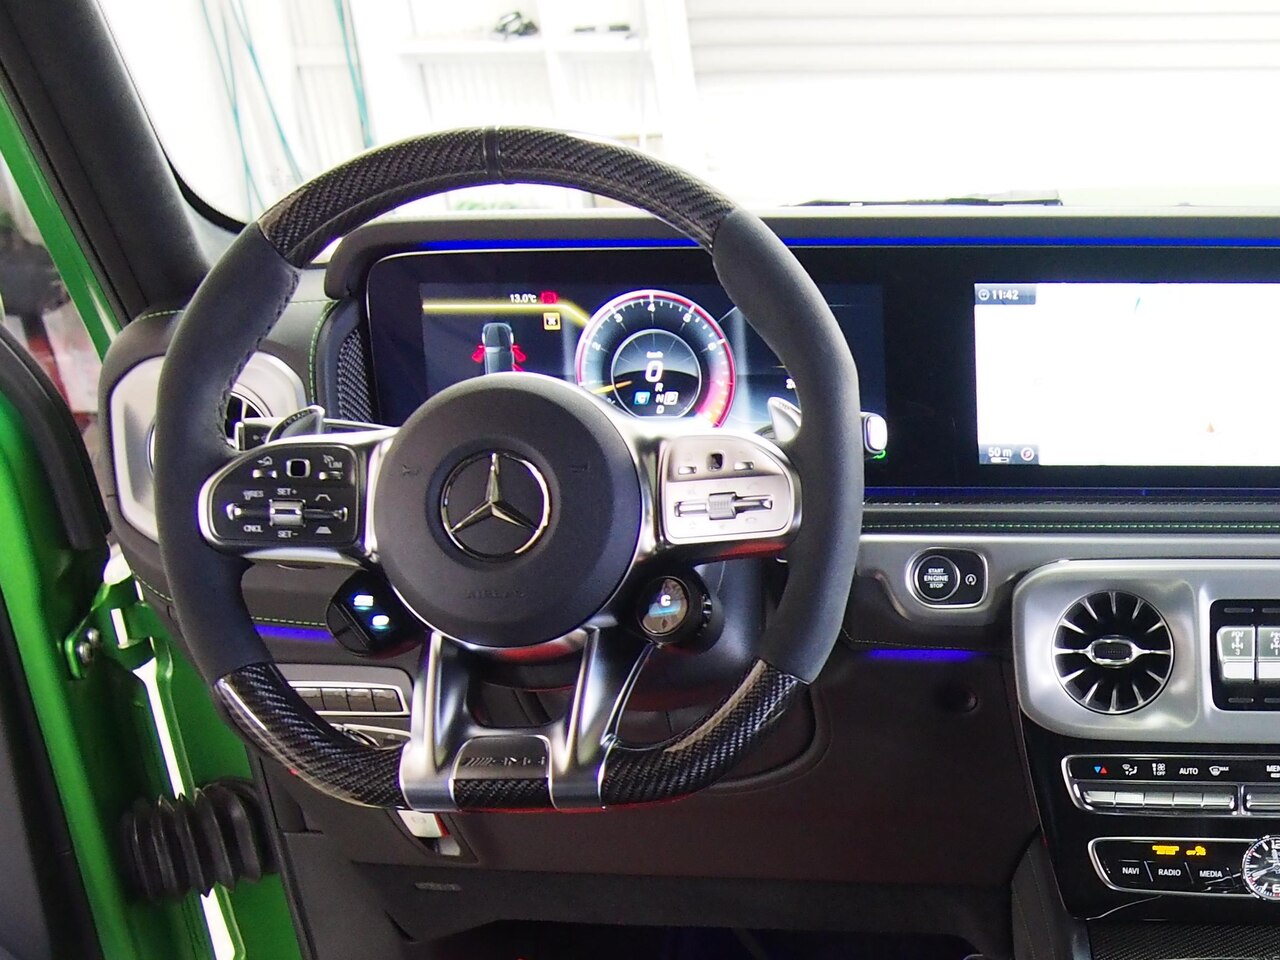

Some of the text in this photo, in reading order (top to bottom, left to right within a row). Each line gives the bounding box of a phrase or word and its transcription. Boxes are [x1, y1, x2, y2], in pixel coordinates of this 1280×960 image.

[992, 289, 1019, 300] 11:42
[645, 360, 664, 383] 0
[988, 447, 1001, 457] 50
[1179, 767, 1199, 775] AUTO
[1122, 867, 1140, 875] NAVI
[1158, 868, 1181, 876] RADIO
[1199, 870, 1223, 878] MEDIA
[1272, 884, 1280, 893] 6
